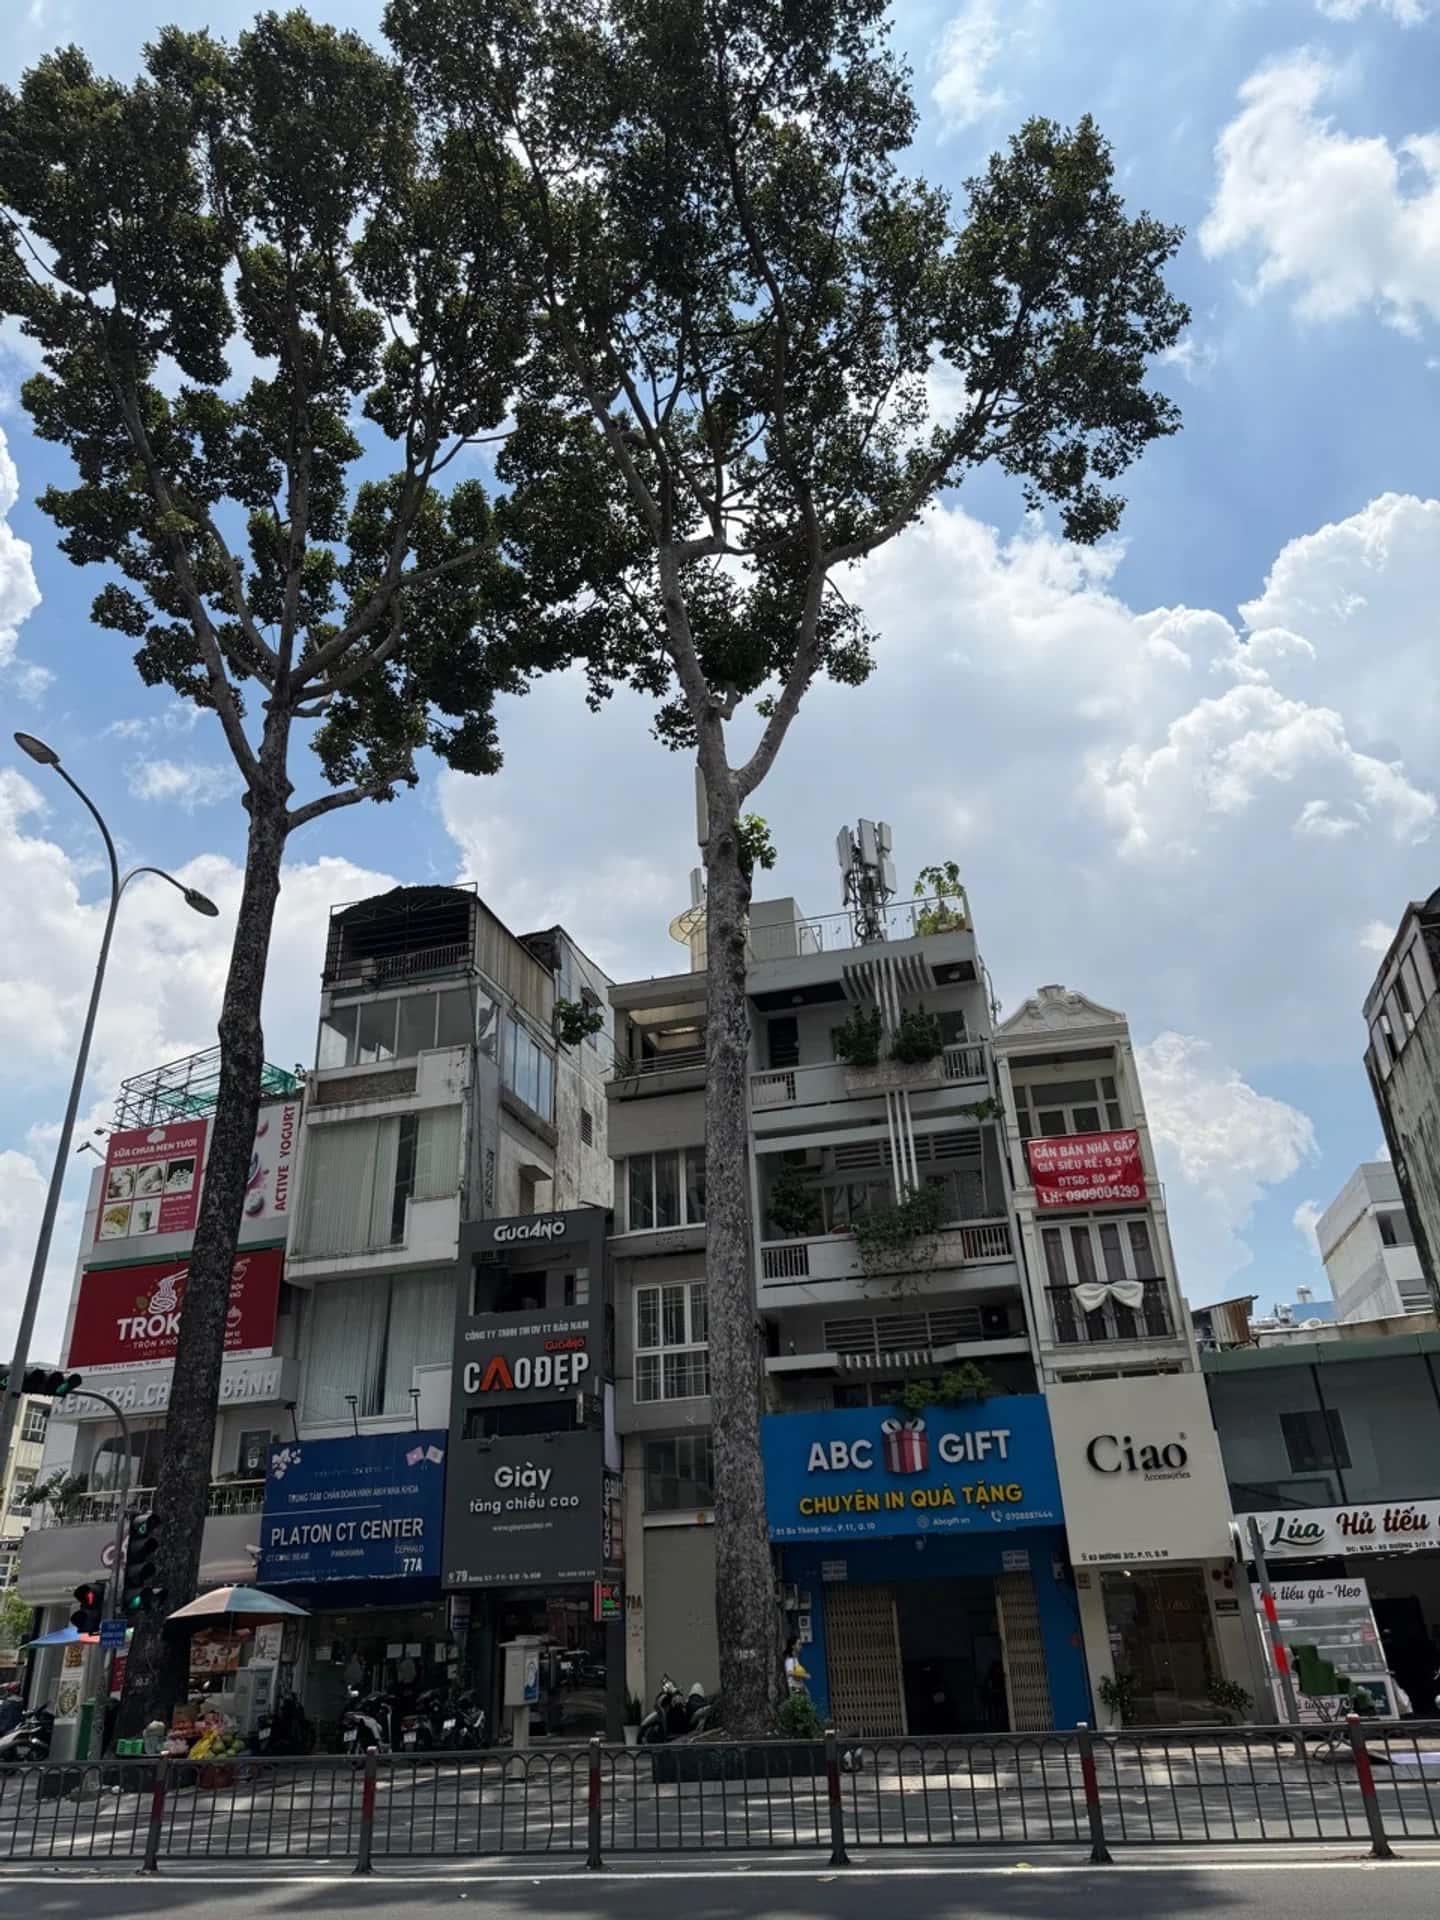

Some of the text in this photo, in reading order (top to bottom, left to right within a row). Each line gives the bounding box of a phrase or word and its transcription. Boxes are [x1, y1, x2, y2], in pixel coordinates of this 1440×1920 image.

[274, 1104, 295, 1212] ACTIVE YOGURT
[1059, 1141, 1084, 1157] BÁN
[1042, 1190, 1062, 1203] LH:
[807, 1429, 1011, 1472] ABC GIFT
[1086, 1434, 1188, 1473] Ciao
[494, 1461, 552, 1490] Giày
[469, 1498, 501, 1514] tăng
[550, 1496, 579, 1507] cao
[799, 1479, 1022, 1515] CHUYÊN IN QUÀ TẶNG
[271, 1518, 424, 1546] PLATON CT CENTER
[1270, 1516, 1325, 1546] Lúa
[1336, 1511, 1376, 1536] Hủ
[1382, 1506, 1430, 1532] tiếu
[403, 1557, 423, 1572] 77A
